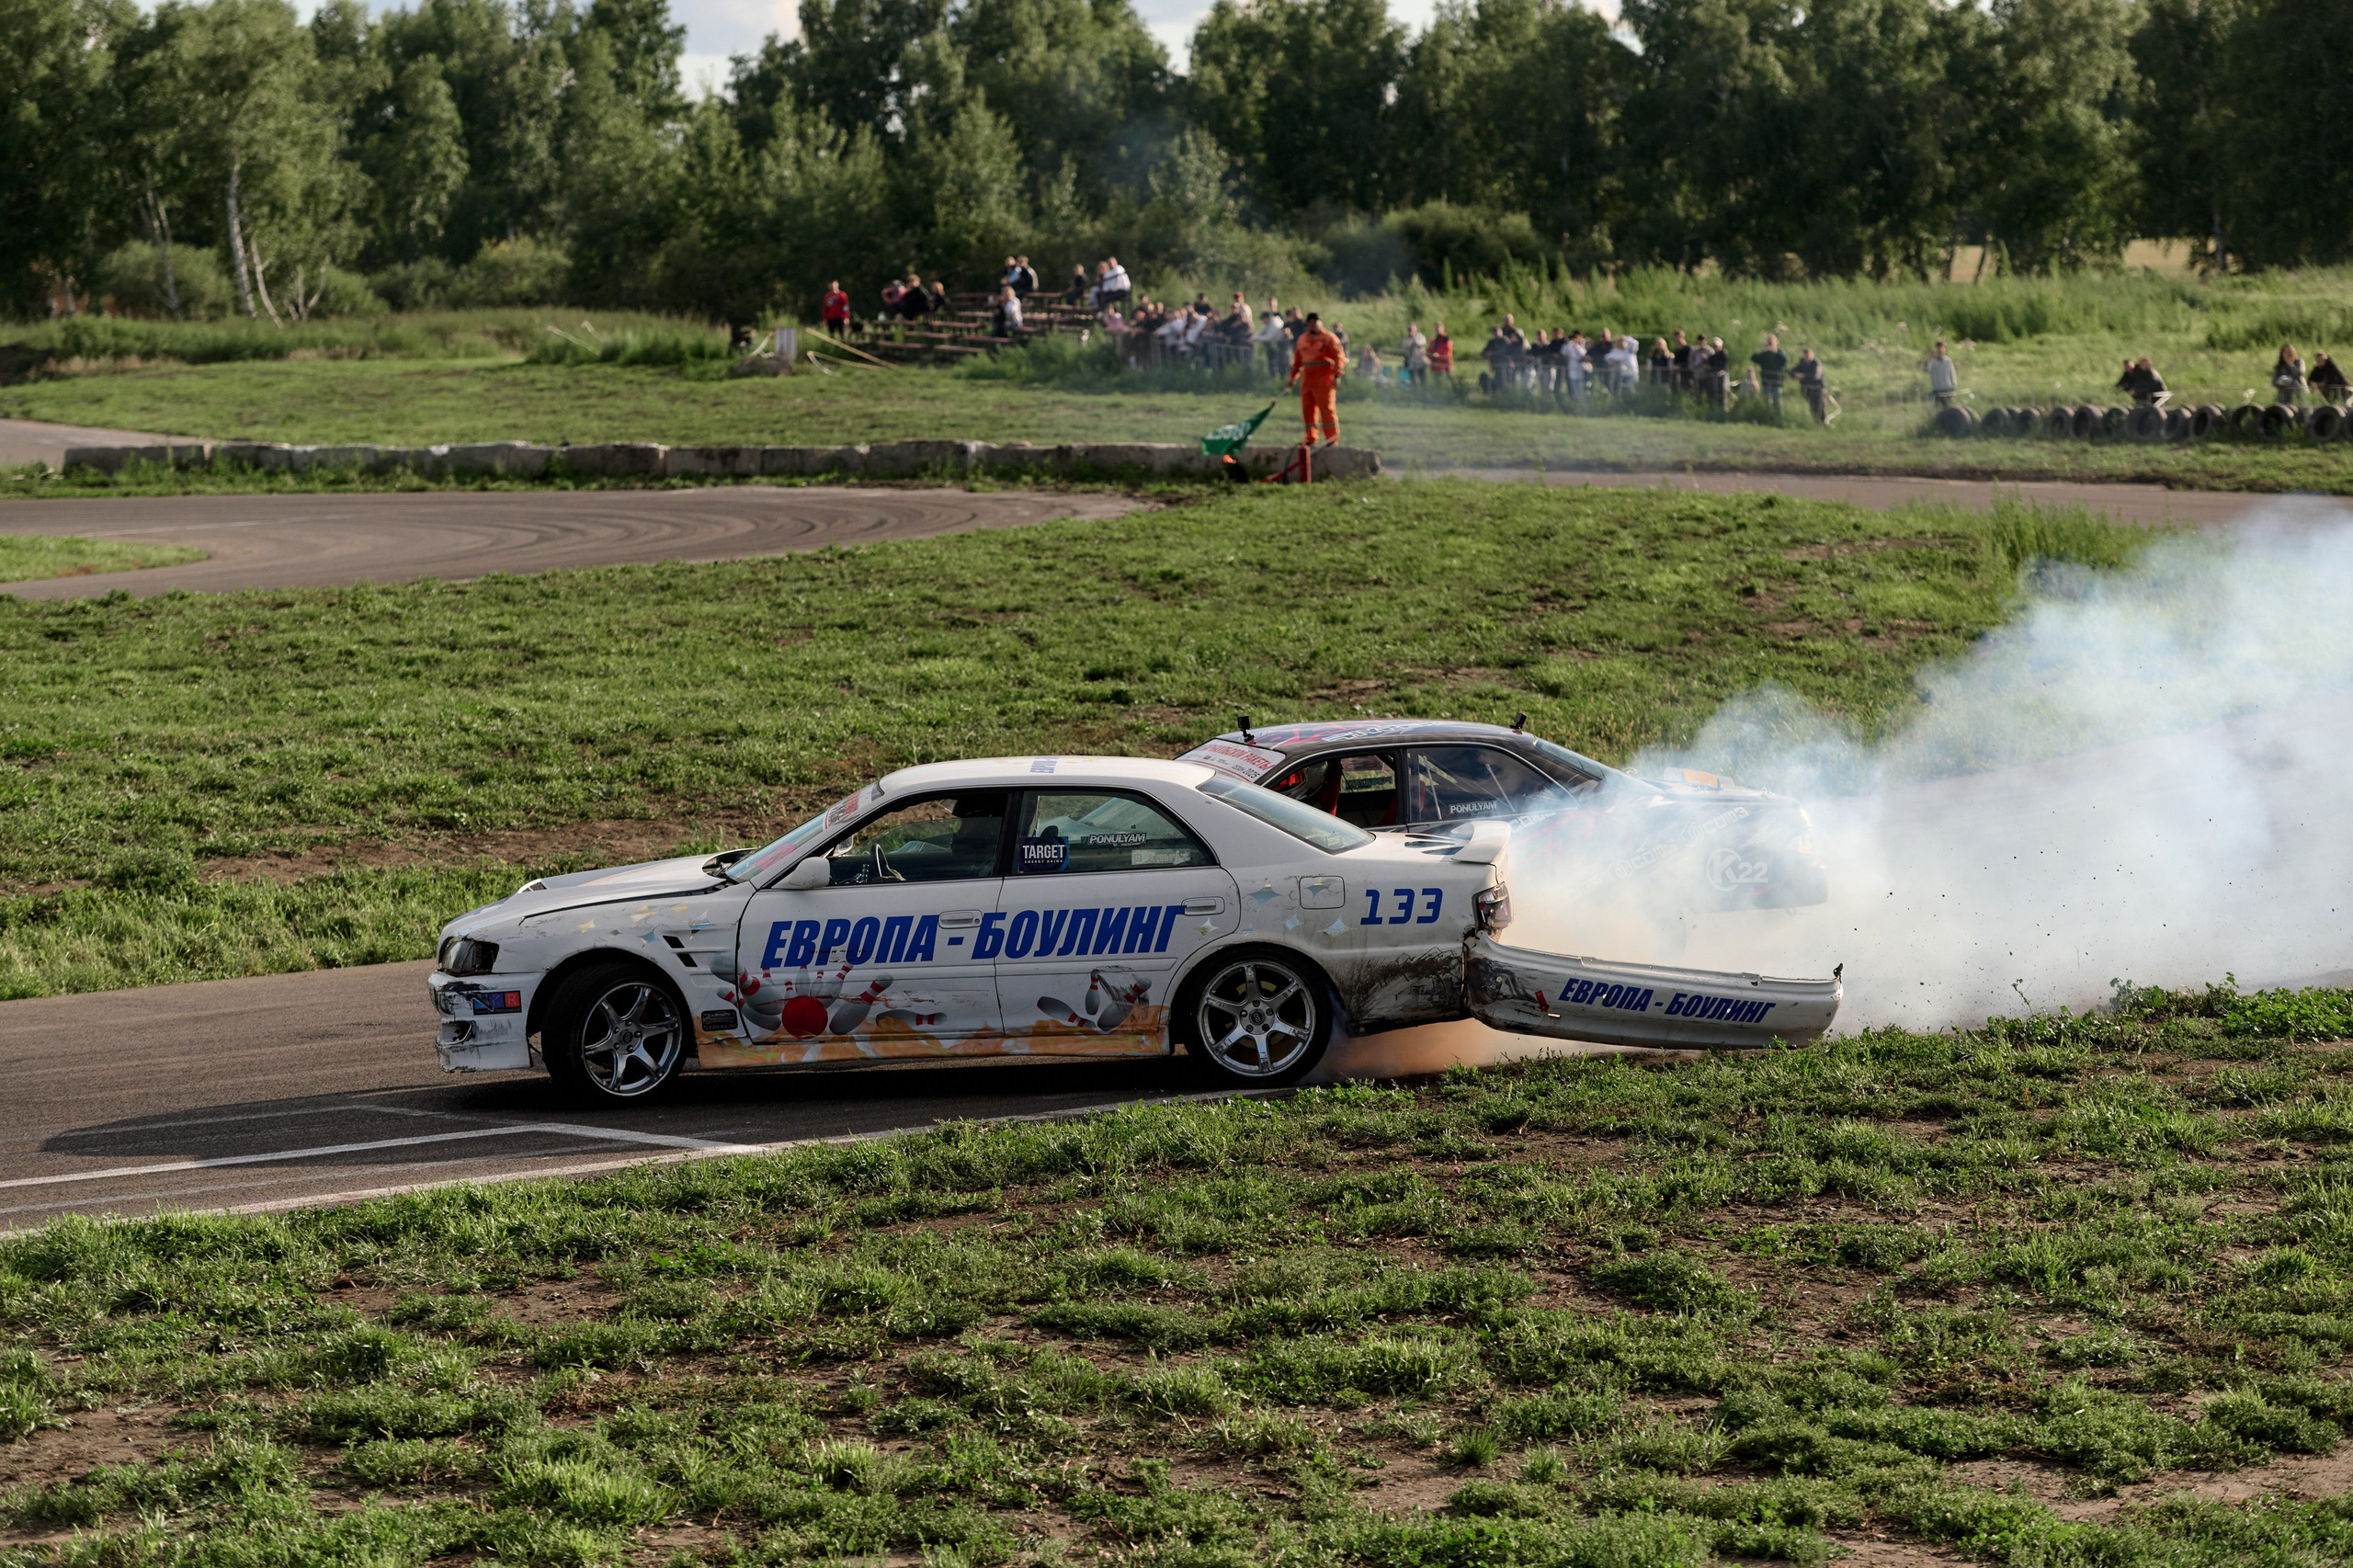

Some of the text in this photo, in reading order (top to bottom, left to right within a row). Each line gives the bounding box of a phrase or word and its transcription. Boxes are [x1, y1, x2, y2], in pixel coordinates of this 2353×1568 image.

[1239, 752, 1276, 771] РАКЕТЫ
[1243, 767, 1260, 778] 2025
[1449, 801, 1497, 813] PONULYAM
[1089, 833, 1146, 844] PONULYAM
[1022, 845, 1065, 858] TARGET
[1360, 888, 1443, 925] 133
[760, 915, 940, 969] ЕВРОПА
[972, 905, 1187, 960] БОУЛИНГ
[1558, 978, 1654, 1012] ЕВРОПА
[1664, 993, 1777, 1023] БОУЛИНГ
